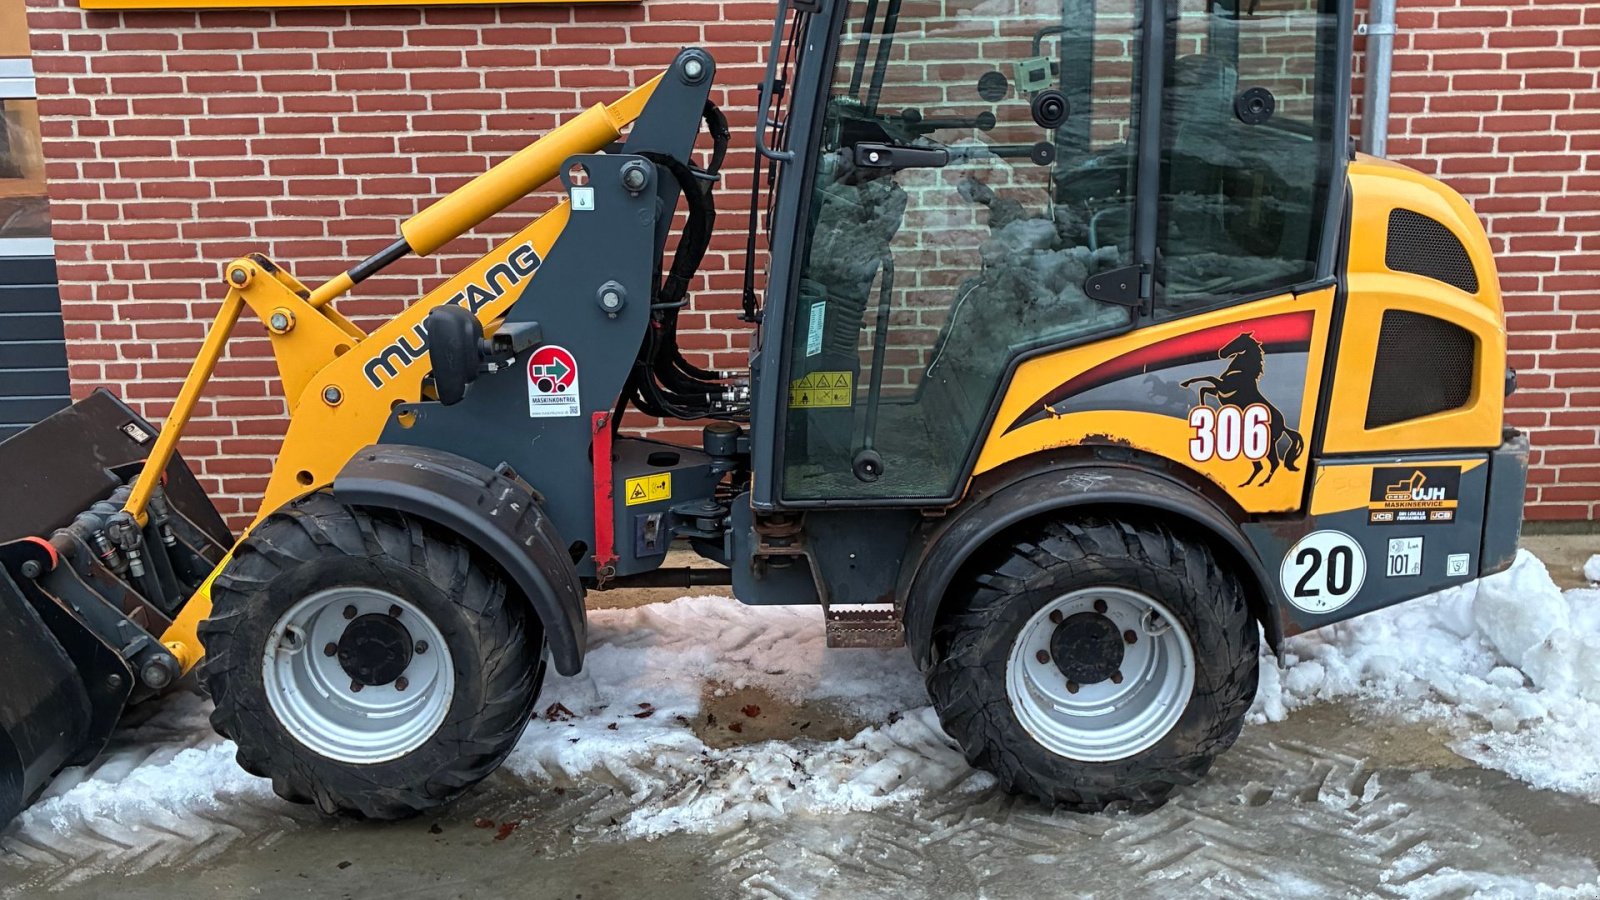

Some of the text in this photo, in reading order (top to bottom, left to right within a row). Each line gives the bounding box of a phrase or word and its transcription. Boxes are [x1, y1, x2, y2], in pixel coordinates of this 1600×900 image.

[363, 243, 542, 390] MUTANG
[1189, 403, 1271, 462] 306
[1412, 487, 1446, 500] UJH
[1432, 511, 1451, 519] JCB
[1294, 545, 1353, 597] 20
[1389, 554, 1409, 575] 101
